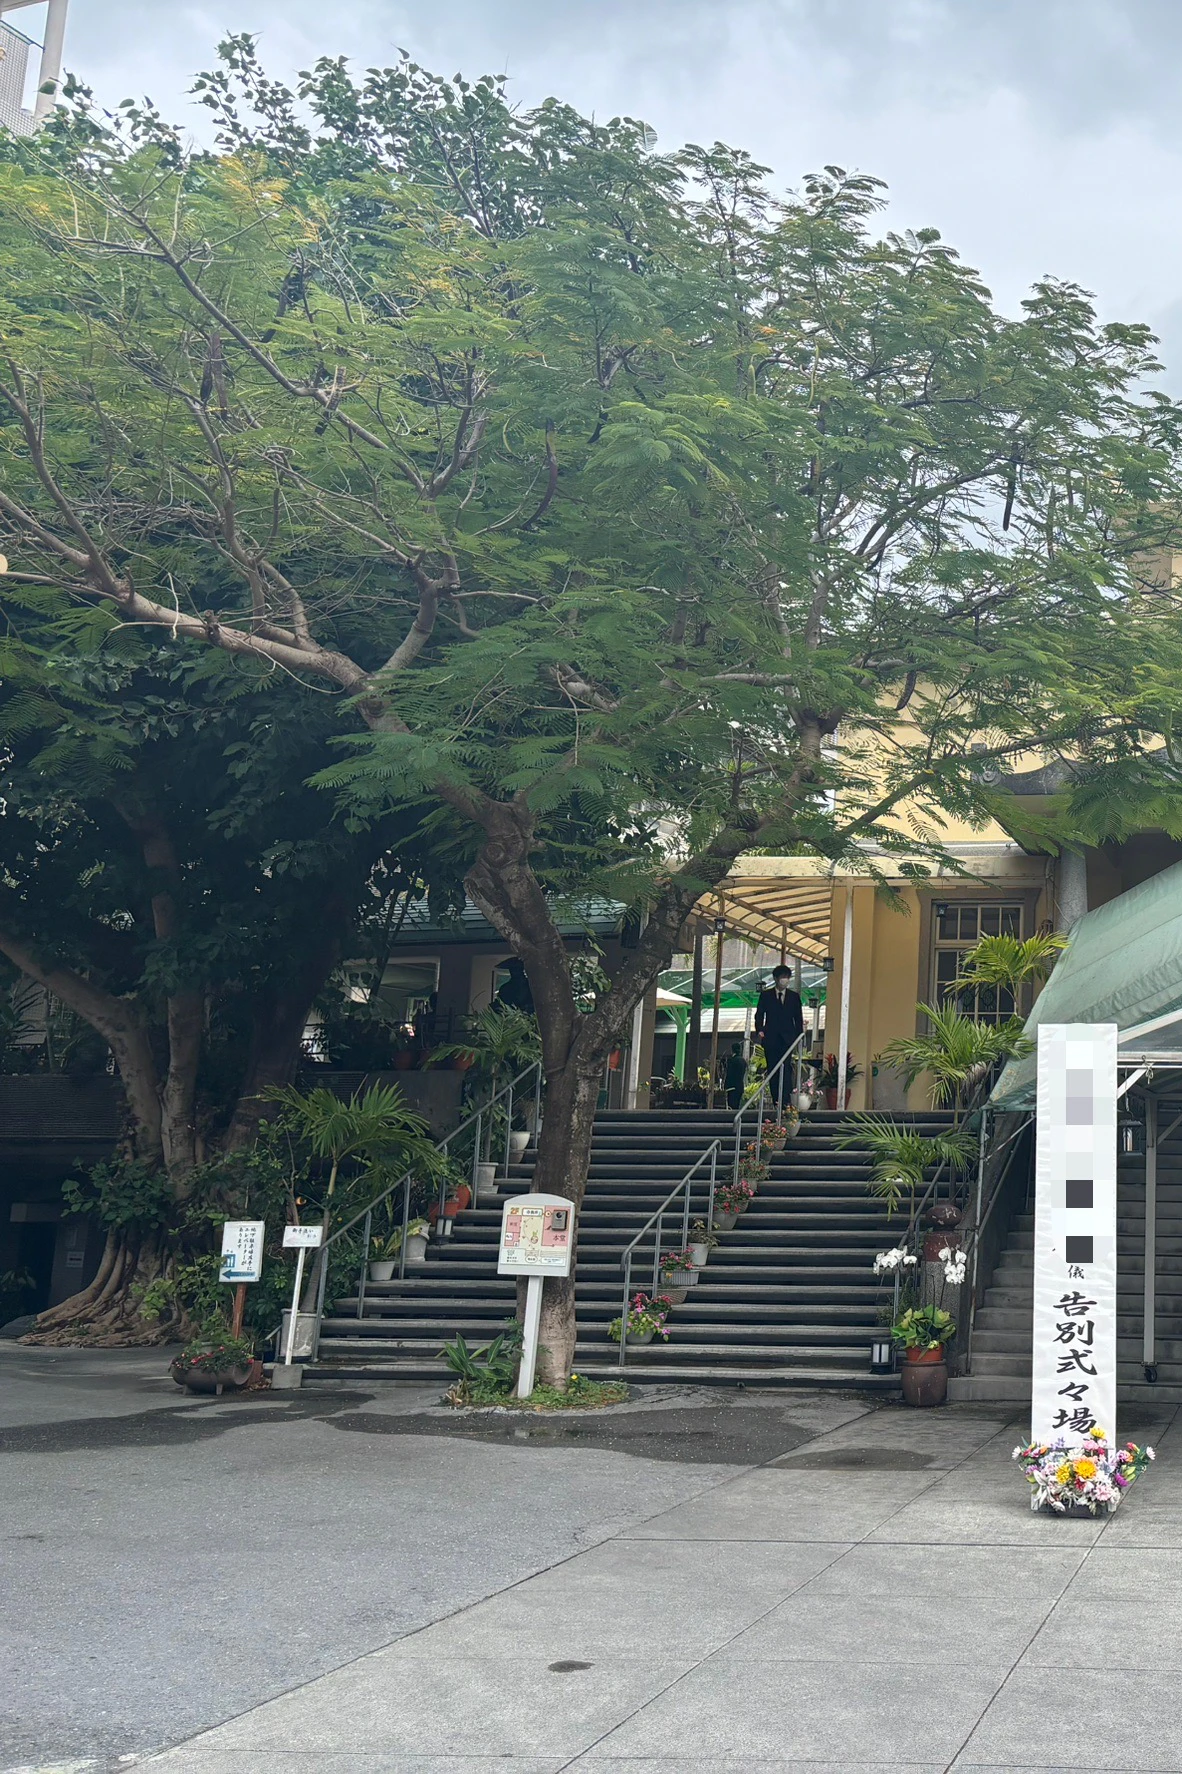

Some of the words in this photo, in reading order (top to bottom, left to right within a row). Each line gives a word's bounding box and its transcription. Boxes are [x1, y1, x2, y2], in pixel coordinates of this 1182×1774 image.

[1068, 1265, 1084, 1279] 儀
[1052, 1291, 1098, 1434] 告別式々場
